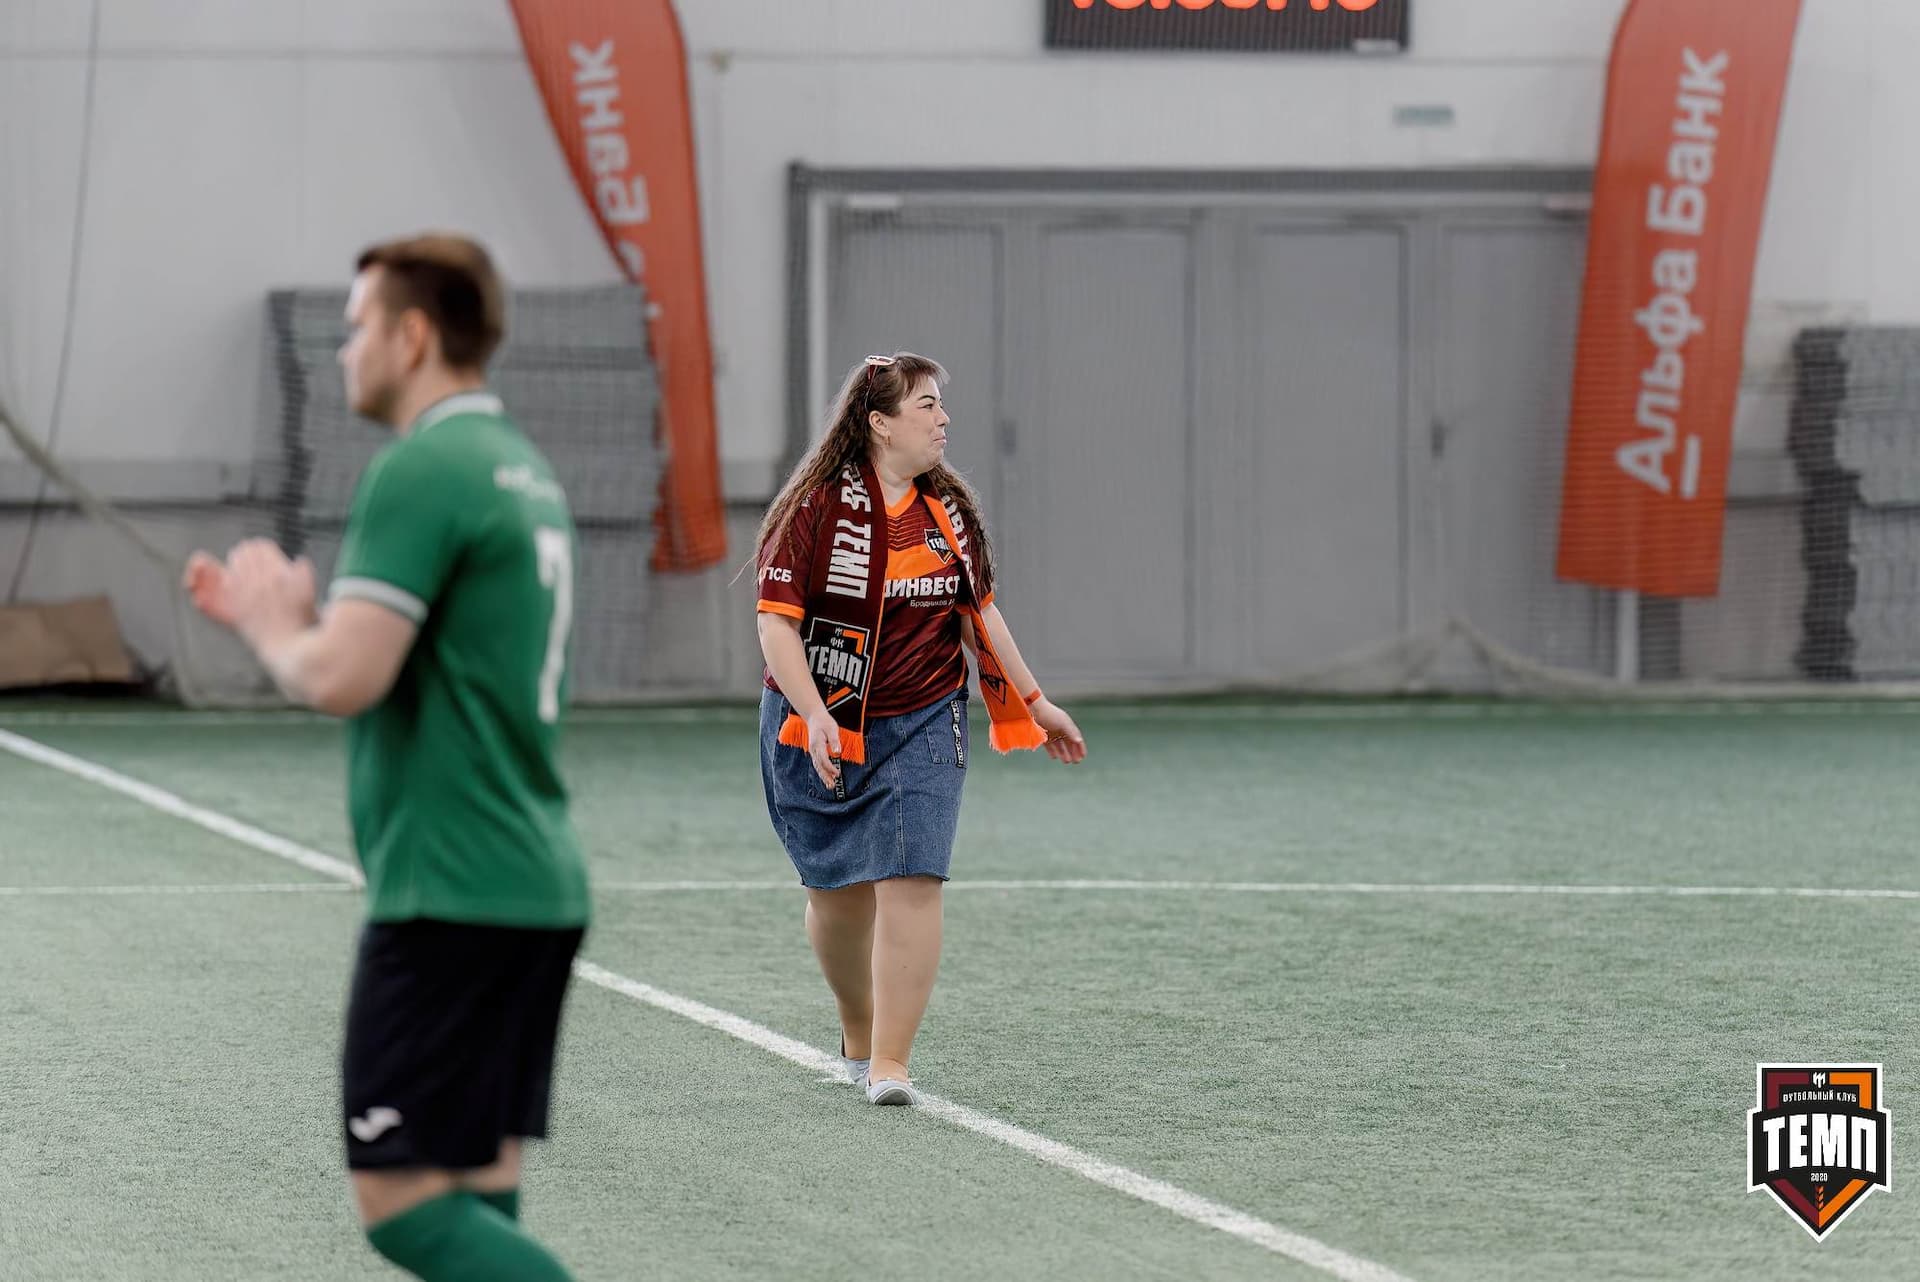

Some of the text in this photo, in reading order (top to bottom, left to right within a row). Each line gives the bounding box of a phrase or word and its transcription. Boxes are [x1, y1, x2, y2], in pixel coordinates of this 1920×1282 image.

[1615, 47, 1730, 494] Альфа Банк
[826, 519, 871, 599] ТЕМП
[533, 526, 573, 724] 7
[830, 637, 845, 649] ФК
[808, 645, 863, 687] ТЕМП
